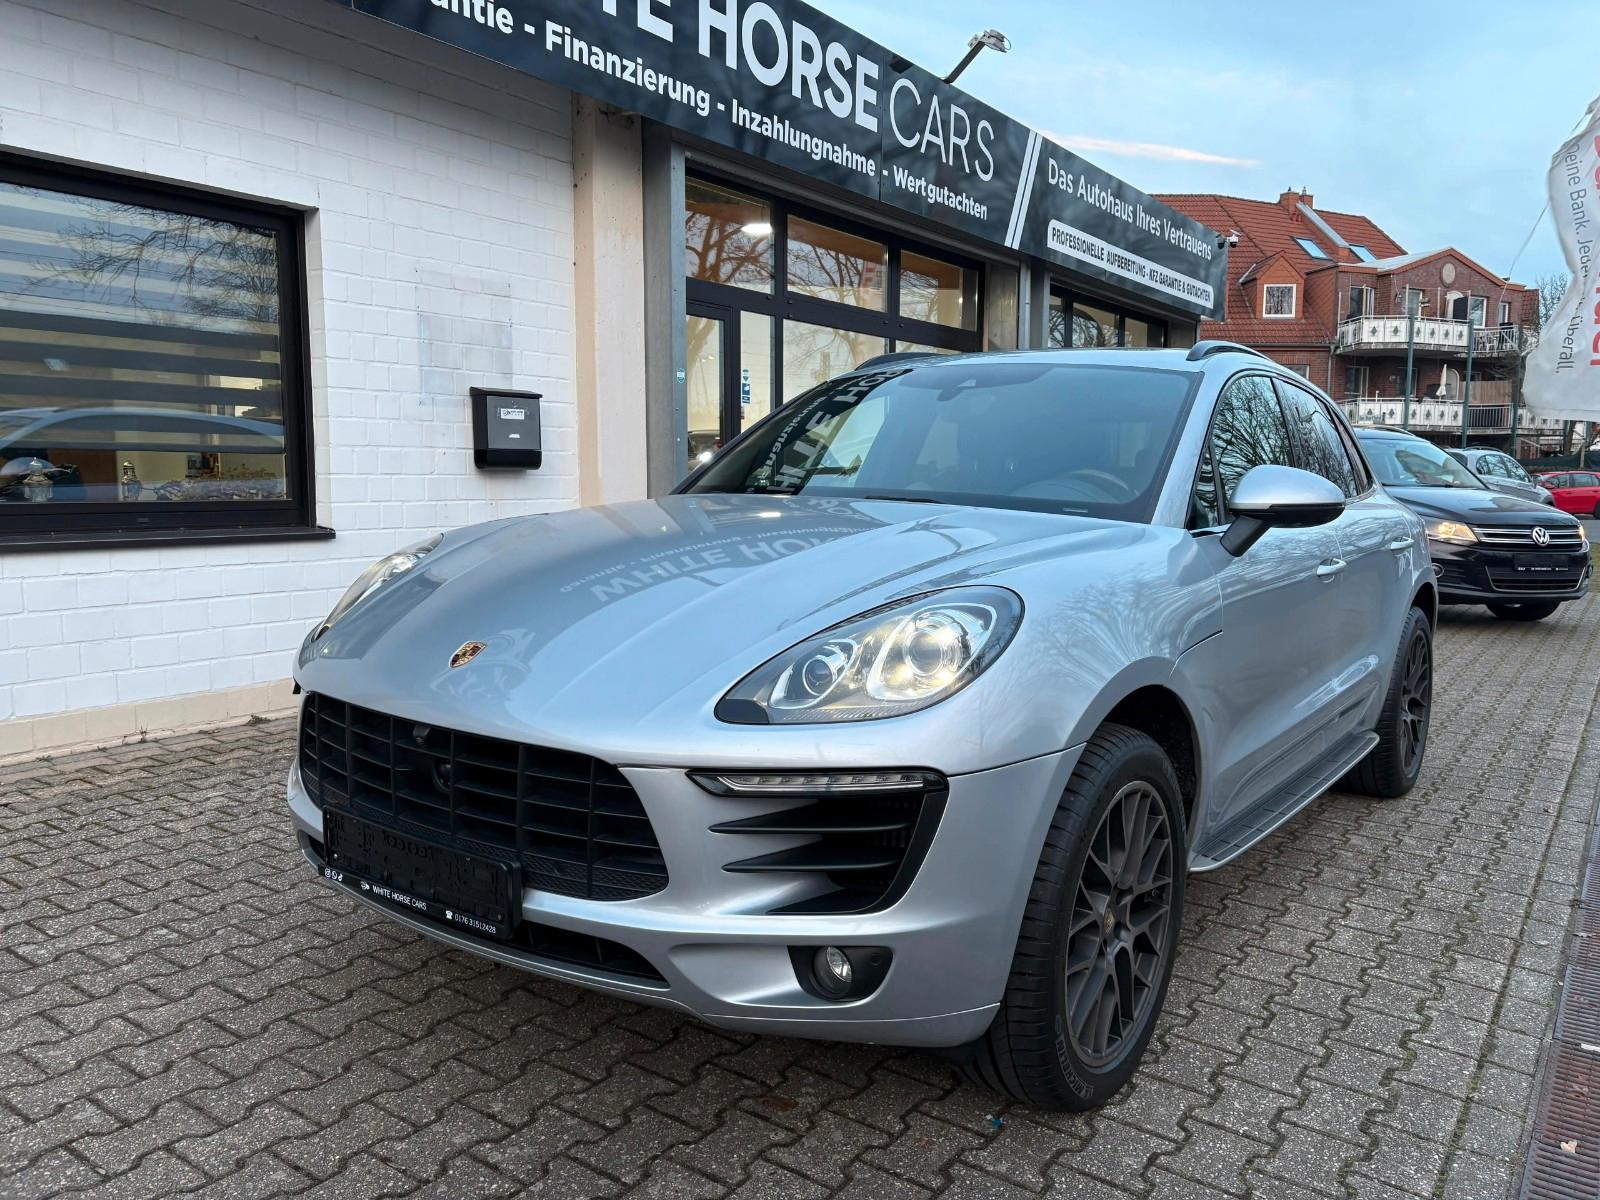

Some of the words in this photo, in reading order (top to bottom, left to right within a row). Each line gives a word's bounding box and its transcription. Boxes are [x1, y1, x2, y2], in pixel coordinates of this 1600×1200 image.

[545, 20, 710, 117] Finanzierung
[732, 98, 876, 177] Inzahlungnahme
[893, 165, 988, 221] Wertgutachten
[698, 0, 879, 133] HORSE
[889, 78, 994, 182] CARS
[1048, 157, 1073, 194] Das
[1077, 175, 1133, 224] Autohaus
[1136, 204, 1161, 237] Ihres
[1163, 218, 1212, 261] Vertrauens
[1570, 188, 1590, 235] Bank.
[1052, 227, 1105, 261] PROFESSIONELLE
[1106, 251, 1146, 279] AUFBEREITUNG
[1149, 268, 1159, 283] KFZ
[1159, 272, 1182, 292] GARANTIE
[1186, 284, 1211, 303] GUTACHTEN
[372, 884, 391, 898] WHITE
[391, 891, 411, 905] HORSE
[411, 898, 427, 911] CARS
[454, 913, 469, 925] 0176
